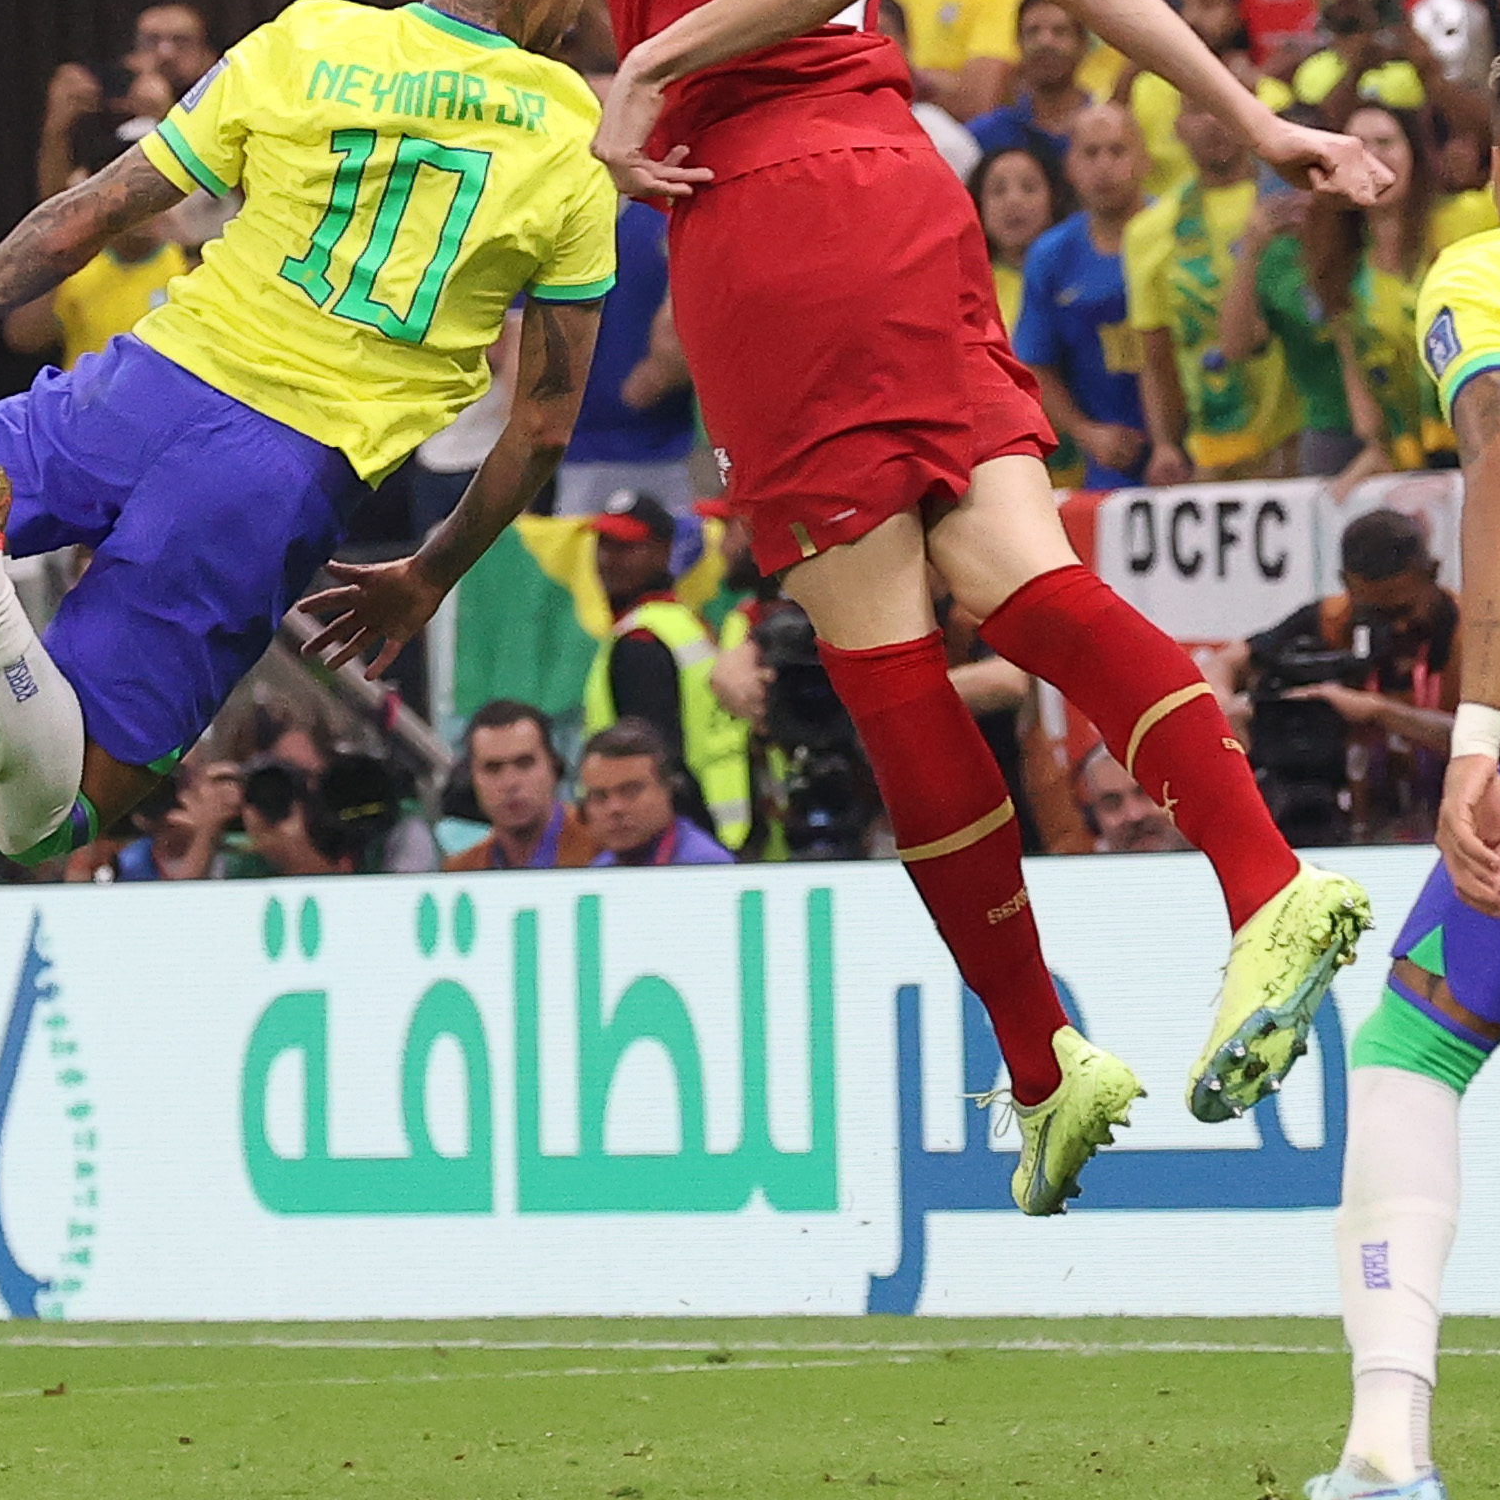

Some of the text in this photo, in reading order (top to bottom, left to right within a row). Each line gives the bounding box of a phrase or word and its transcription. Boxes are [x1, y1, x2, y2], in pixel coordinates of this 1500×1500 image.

[306, 60, 548, 134] NEYMAR JR
[278, 127, 493, 344] 10
[240, 888, 841, 1215] للطاقة
